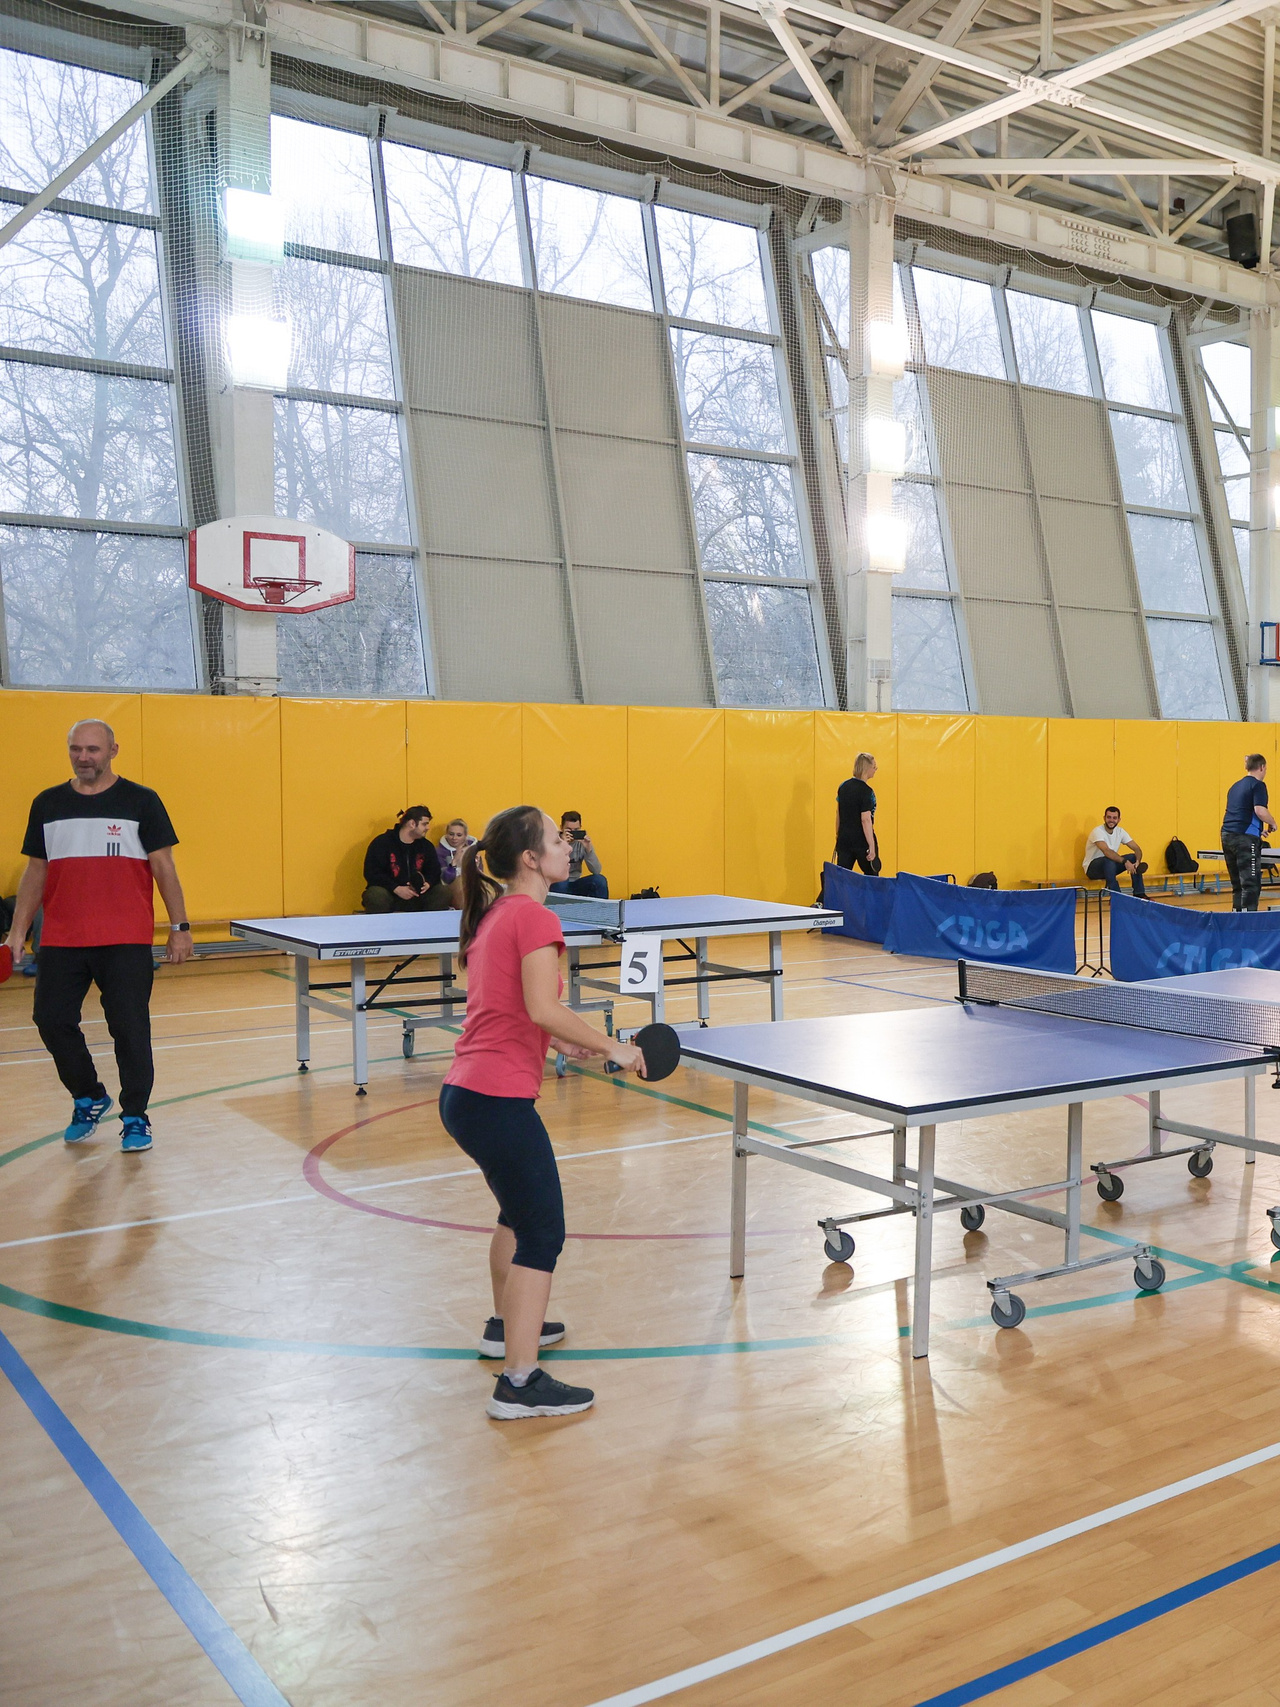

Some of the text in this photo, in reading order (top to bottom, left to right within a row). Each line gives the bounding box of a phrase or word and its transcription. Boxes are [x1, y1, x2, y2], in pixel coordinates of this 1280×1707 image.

[813, 919, 836, 927] Champion
[334, 948, 379, 957] START LINE
[627, 951, 649, 985] 5
